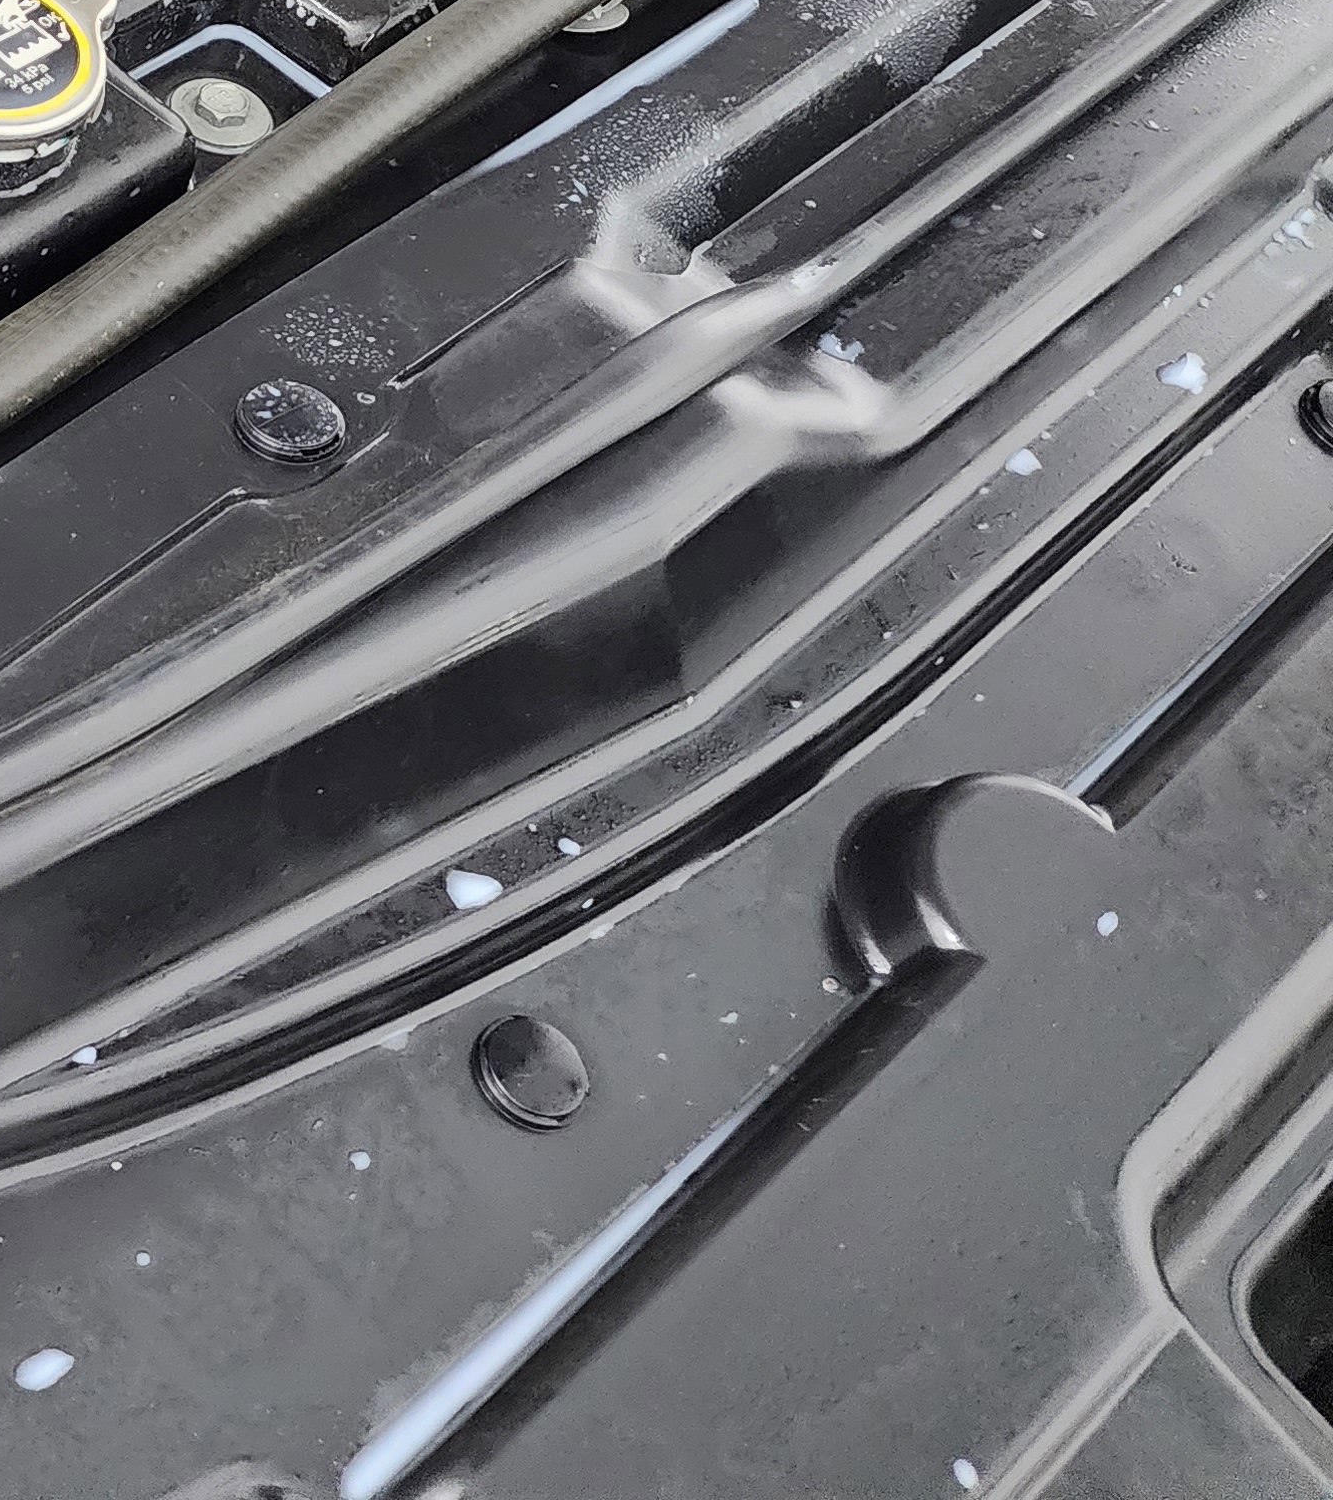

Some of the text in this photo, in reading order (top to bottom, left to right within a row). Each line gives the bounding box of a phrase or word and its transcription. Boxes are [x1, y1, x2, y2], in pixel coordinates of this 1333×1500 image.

[38, 11, 64, 29] OK
[4, 62, 51, 90] 34 kPa
[21, 74, 56, 96] 5 psi
